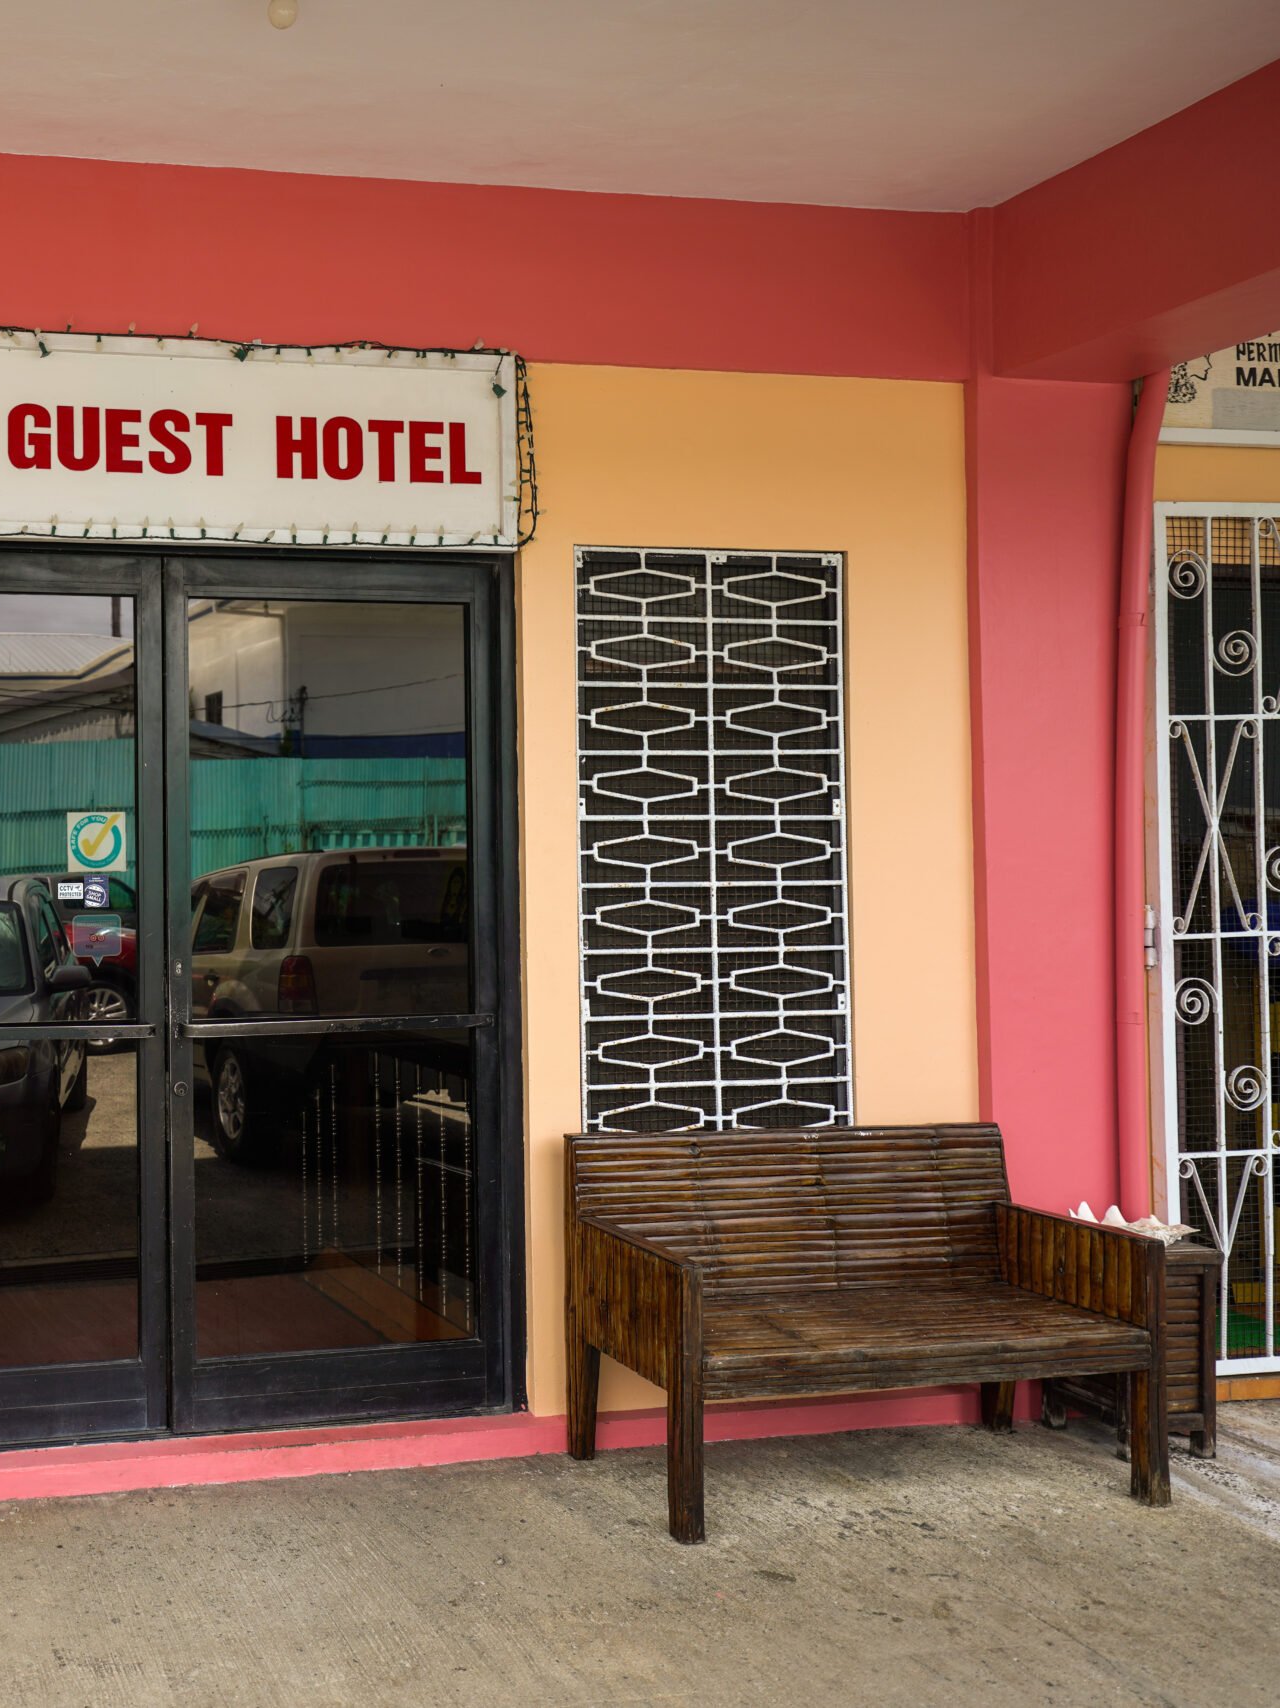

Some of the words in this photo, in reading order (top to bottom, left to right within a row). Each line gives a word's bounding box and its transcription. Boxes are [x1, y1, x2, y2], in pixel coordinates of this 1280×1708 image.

[1236, 366, 1280, 387] MA
[7, 403, 233, 477] GUEST
[275, 415, 483, 485] HOTEL
[70, 829, 78, 850] SAFE
[77, 817, 89, 829] FOR
